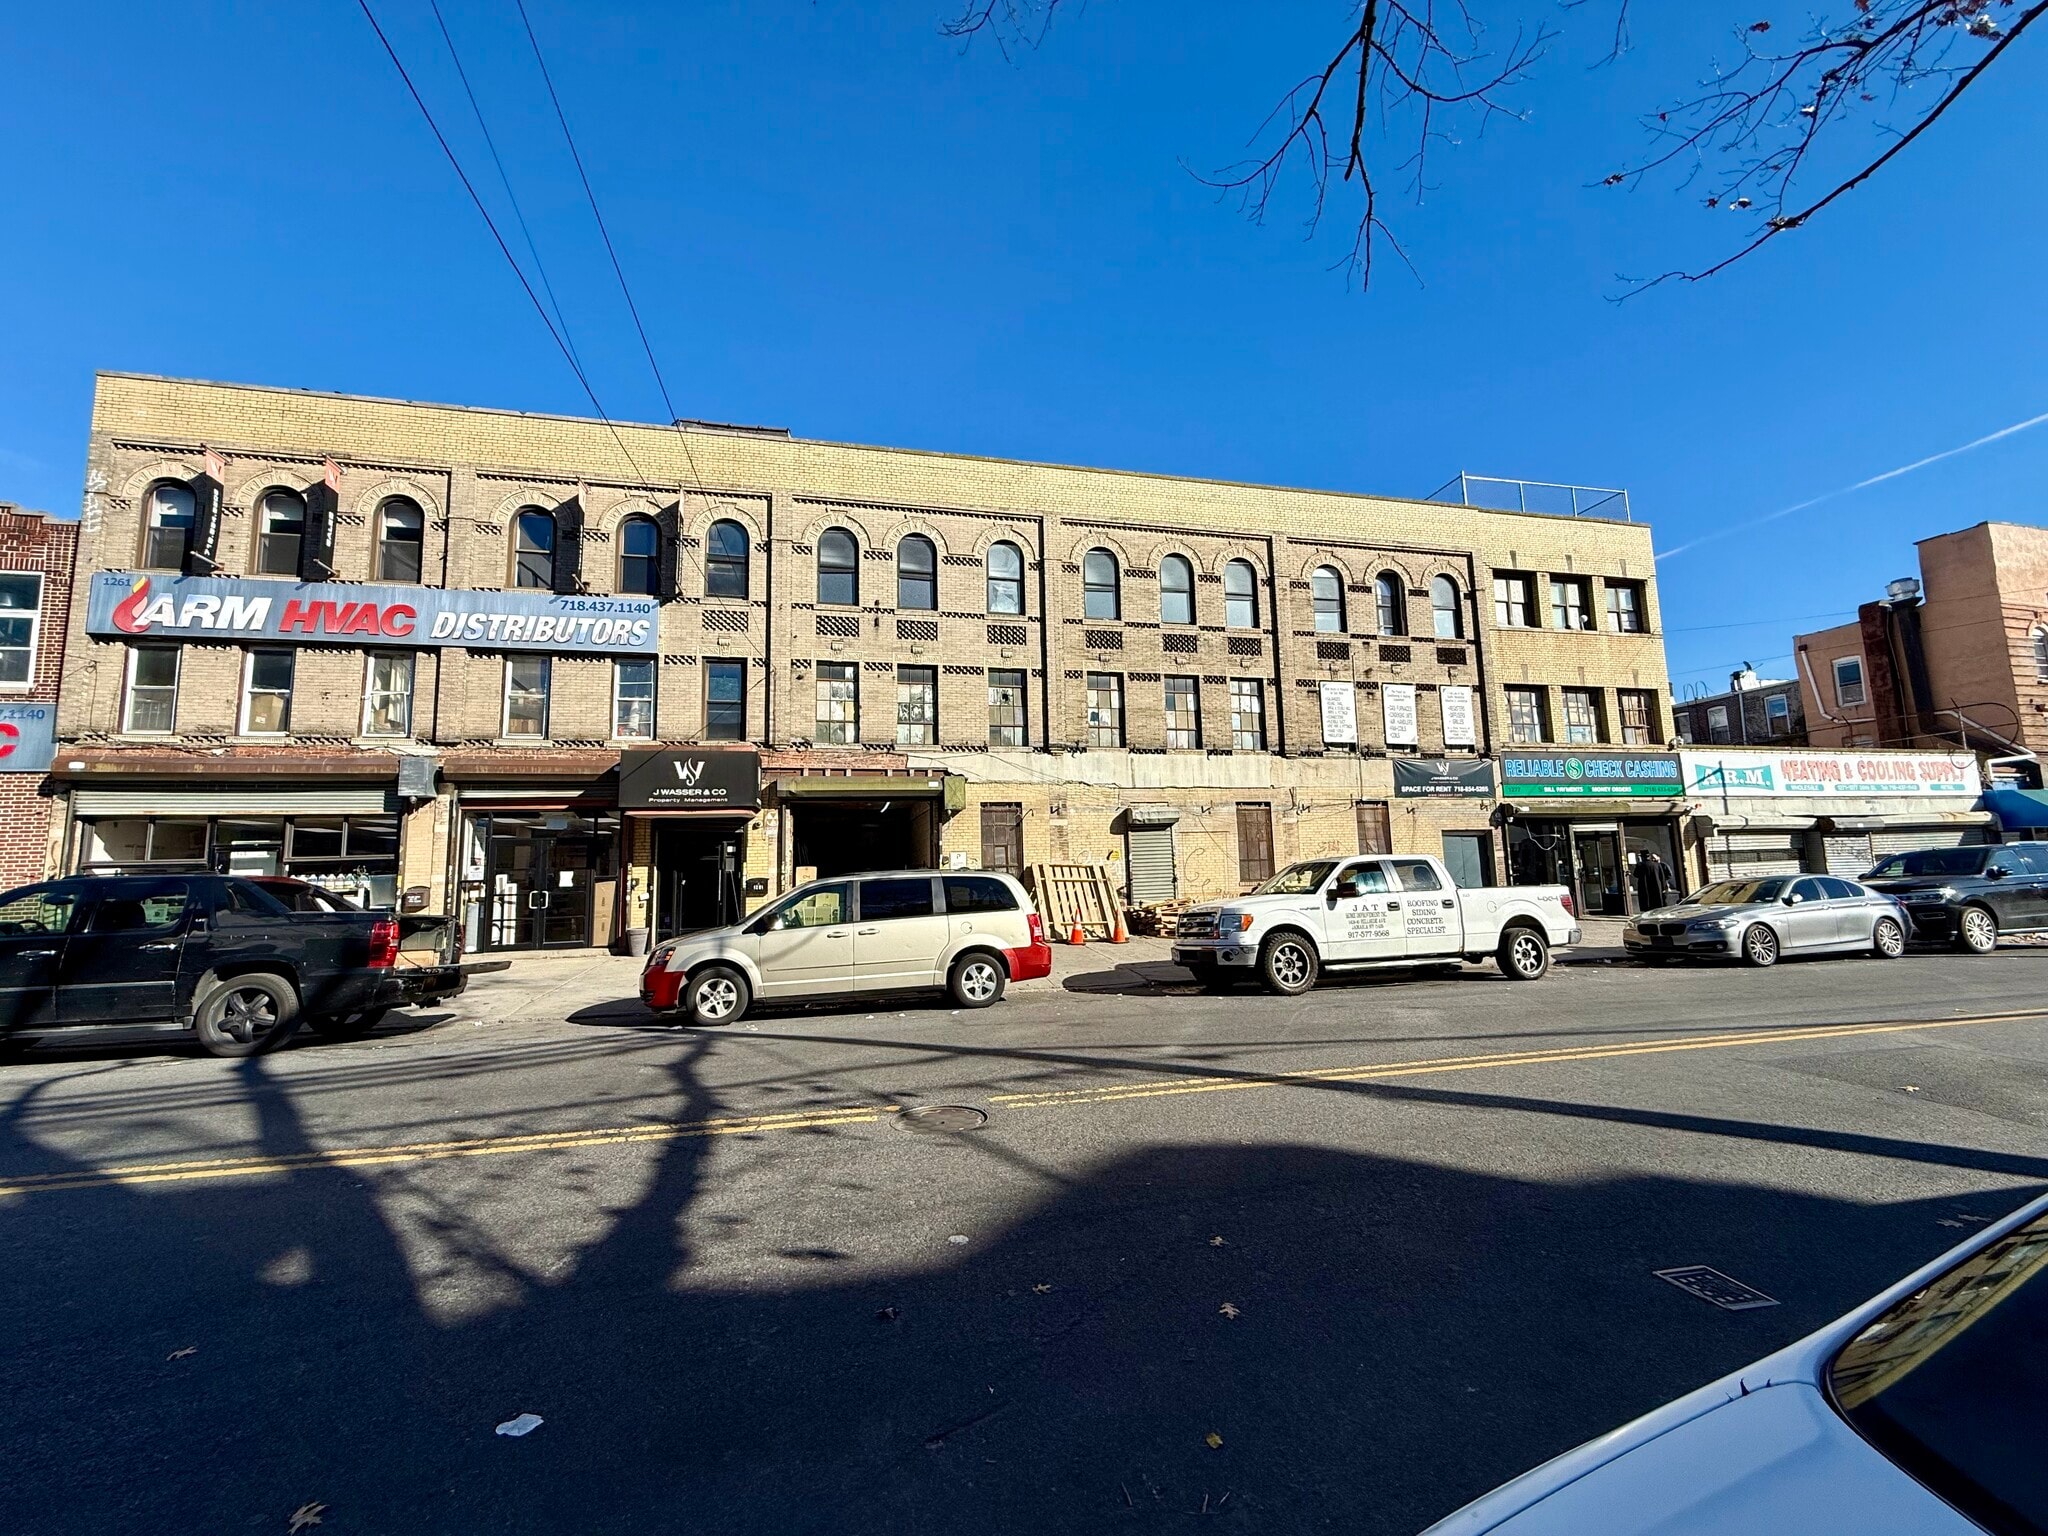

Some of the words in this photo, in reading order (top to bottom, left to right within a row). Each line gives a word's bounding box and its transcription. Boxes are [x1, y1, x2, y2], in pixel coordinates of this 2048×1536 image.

[102, 577, 131, 587] 1261
[560, 599, 650, 614] 718.437.1140
[132, 592, 273, 632] ARM
[278, 598, 417, 638] HVAC
[430, 610, 651, 647] DISTRIBUTORS
[1504, 758, 1565, 778] RELIABLE
[1585, 759, 1625, 779] CHECK
[1625, 760, 1678, 779] CASHING
[1780, 759, 1841, 782] HEATING
[1844, 762, 1853, 780] &
[1857, 760, 1915, 782] COOLING
[1918, 760, 1965, 782] SUPPLY
[1701, 767, 1770, 788] A.R.M.
[652, 788, 659, 796] J
[661, 788, 702, 796] WASSER
[703, 788, 710, 796] &
[712, 788, 727, 796] CO
[1401, 785, 1421, 793] SPACE
[1422, 785, 1435, 793] FOR
[1435, 785, 1452, 793] RENT
[1406, 917, 1444, 926] CONCRETE
[1406, 926, 1446, 935] SPECIALIST
